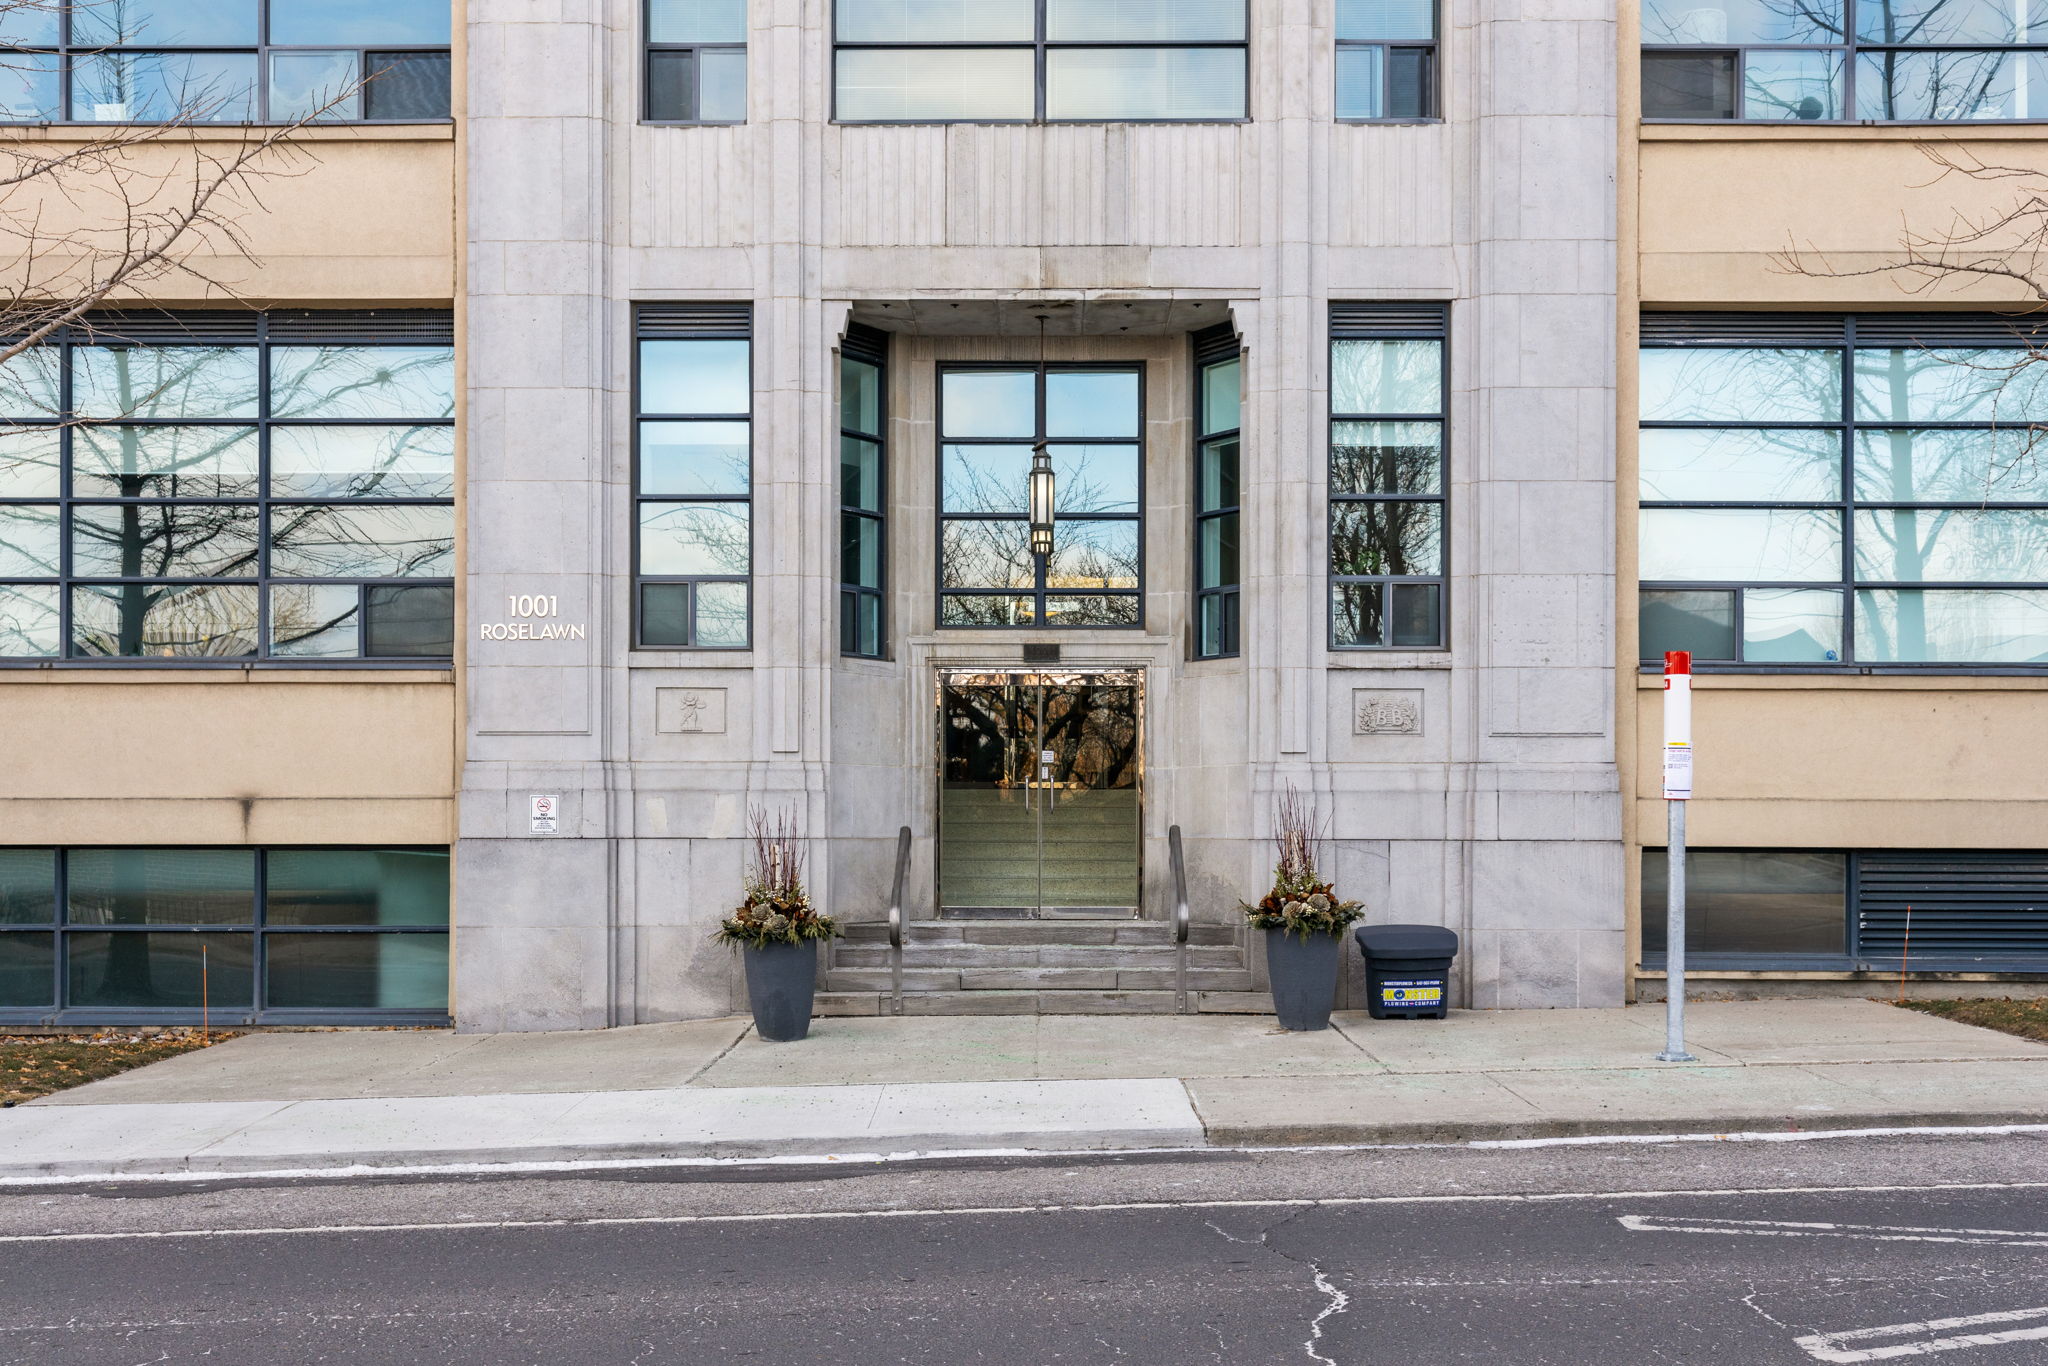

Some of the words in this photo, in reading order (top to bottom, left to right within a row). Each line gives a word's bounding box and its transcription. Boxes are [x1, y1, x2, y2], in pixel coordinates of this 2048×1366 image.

[509, 594, 557, 618] 1001
[480, 623, 585, 641] ROSELAWN
[1384, 988, 1440, 1000] MONSTER
